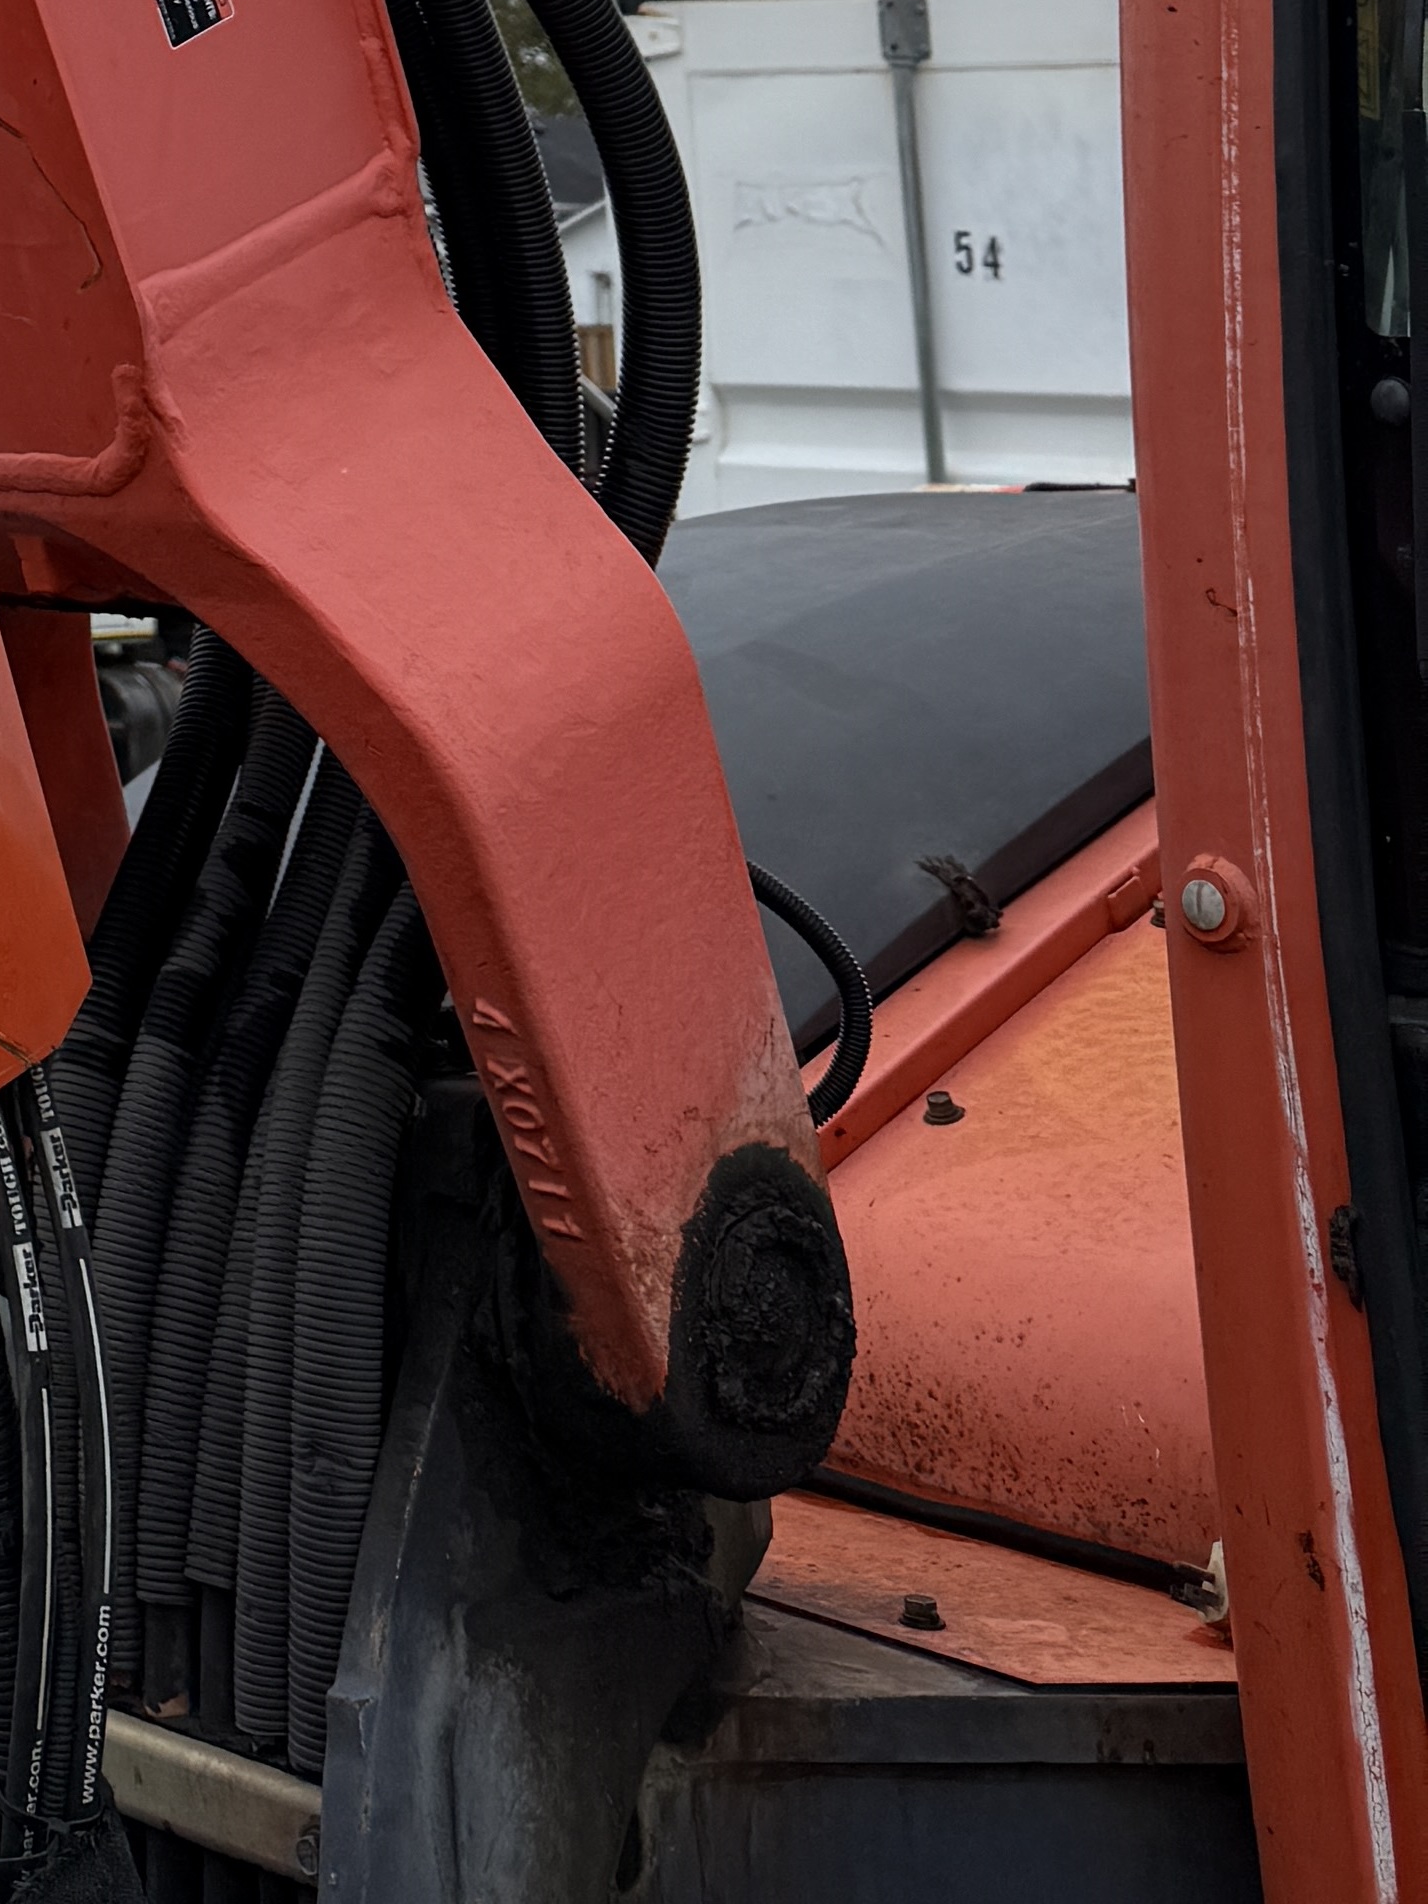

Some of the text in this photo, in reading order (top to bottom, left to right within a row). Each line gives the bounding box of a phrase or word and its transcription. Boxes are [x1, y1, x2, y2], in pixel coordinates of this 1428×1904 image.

[953, 230, 1004, 281] 54
[48, 1133, 79, 1228] Parker
[20, 1247, 47, 1351] Parker
[82, 1605, 111, 1805] www.parker.com
